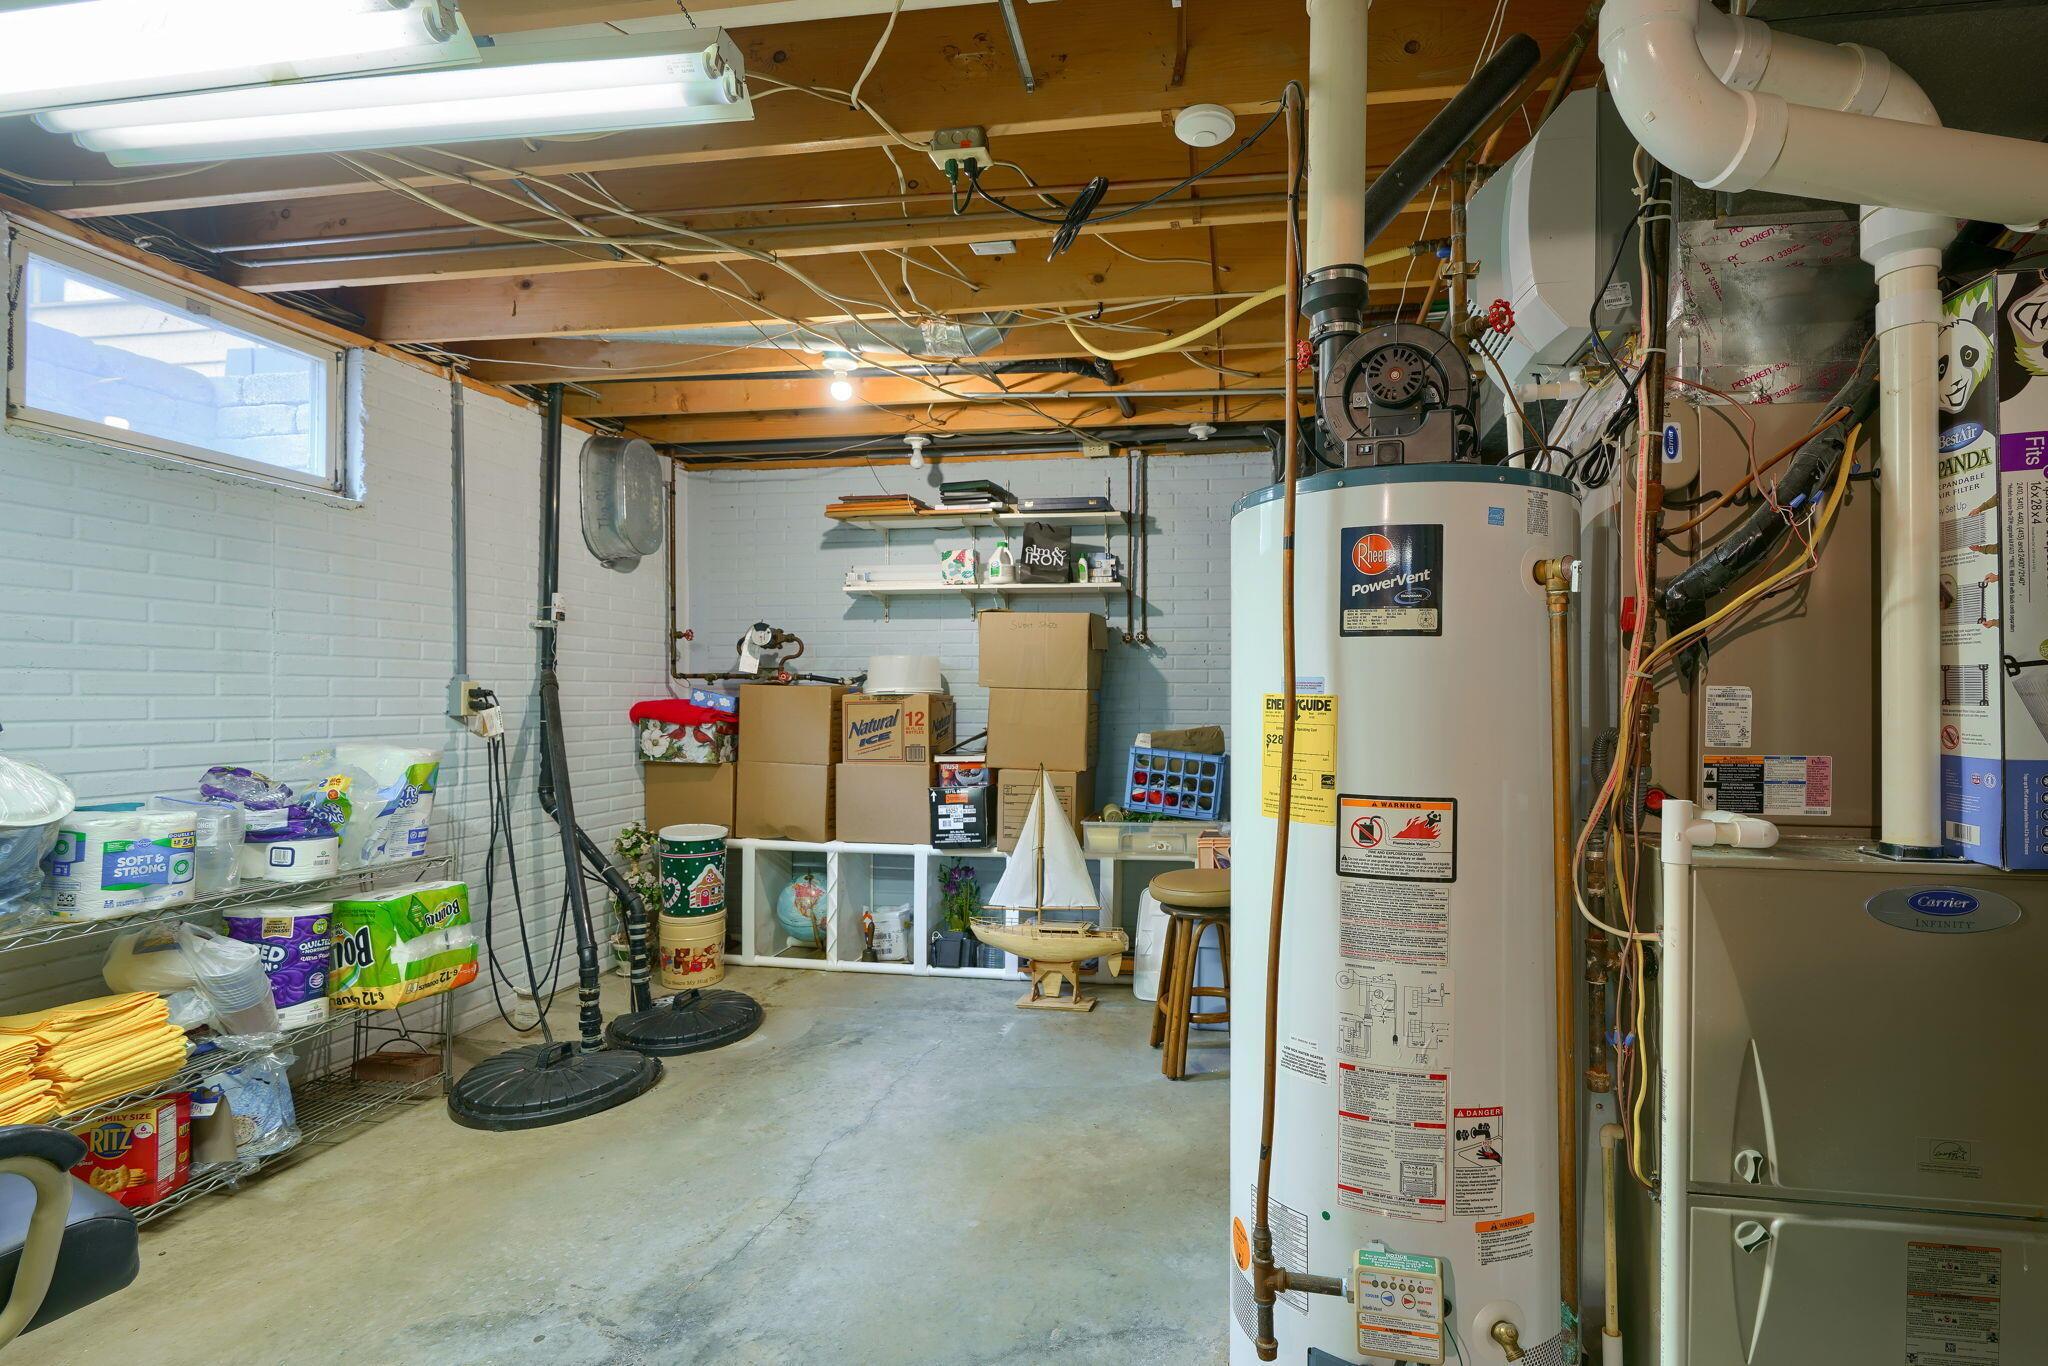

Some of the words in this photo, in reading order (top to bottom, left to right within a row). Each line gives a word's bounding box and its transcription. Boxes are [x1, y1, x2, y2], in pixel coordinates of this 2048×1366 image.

[1740, 227, 1776, 248] OLYKEN
[1731, 367, 1772, 391] POLYKEN
[2025, 436, 2045, 466] Fits
[1939, 472, 1985, 490] PANDABLE
[1952, 483, 1980, 496] FILTER
[1025, 544, 1050, 556] elm
[1050, 547, 1067, 558] &
[1025, 553, 1064, 567] IRON
[1351, 569, 1431, 597] PowerVent
[1266, 698, 1332, 712] ENEYGUIDE
[848, 708, 900, 739] Natural
[905, 711, 925, 727] 12
[859, 731, 892, 748] ICE
[1266, 734, 1284, 745] $28
[1381, 801, 1422, 809] WARNING
[117, 854, 155, 867] SOFT
[155, 854, 164, 862] &
[114, 864, 167, 878] STRONG
[1917, 896, 1970, 910] Carrier
[424, 899, 461, 927] Bounty
[1915, 919, 1972, 929] INFINITY
[97, 1113, 129, 1122] AMILY
[1466, 1108, 1501, 1117] DANGER
[90, 1127, 134, 1153] RITZ
[1500, 1219, 1524, 1228] WARNING
